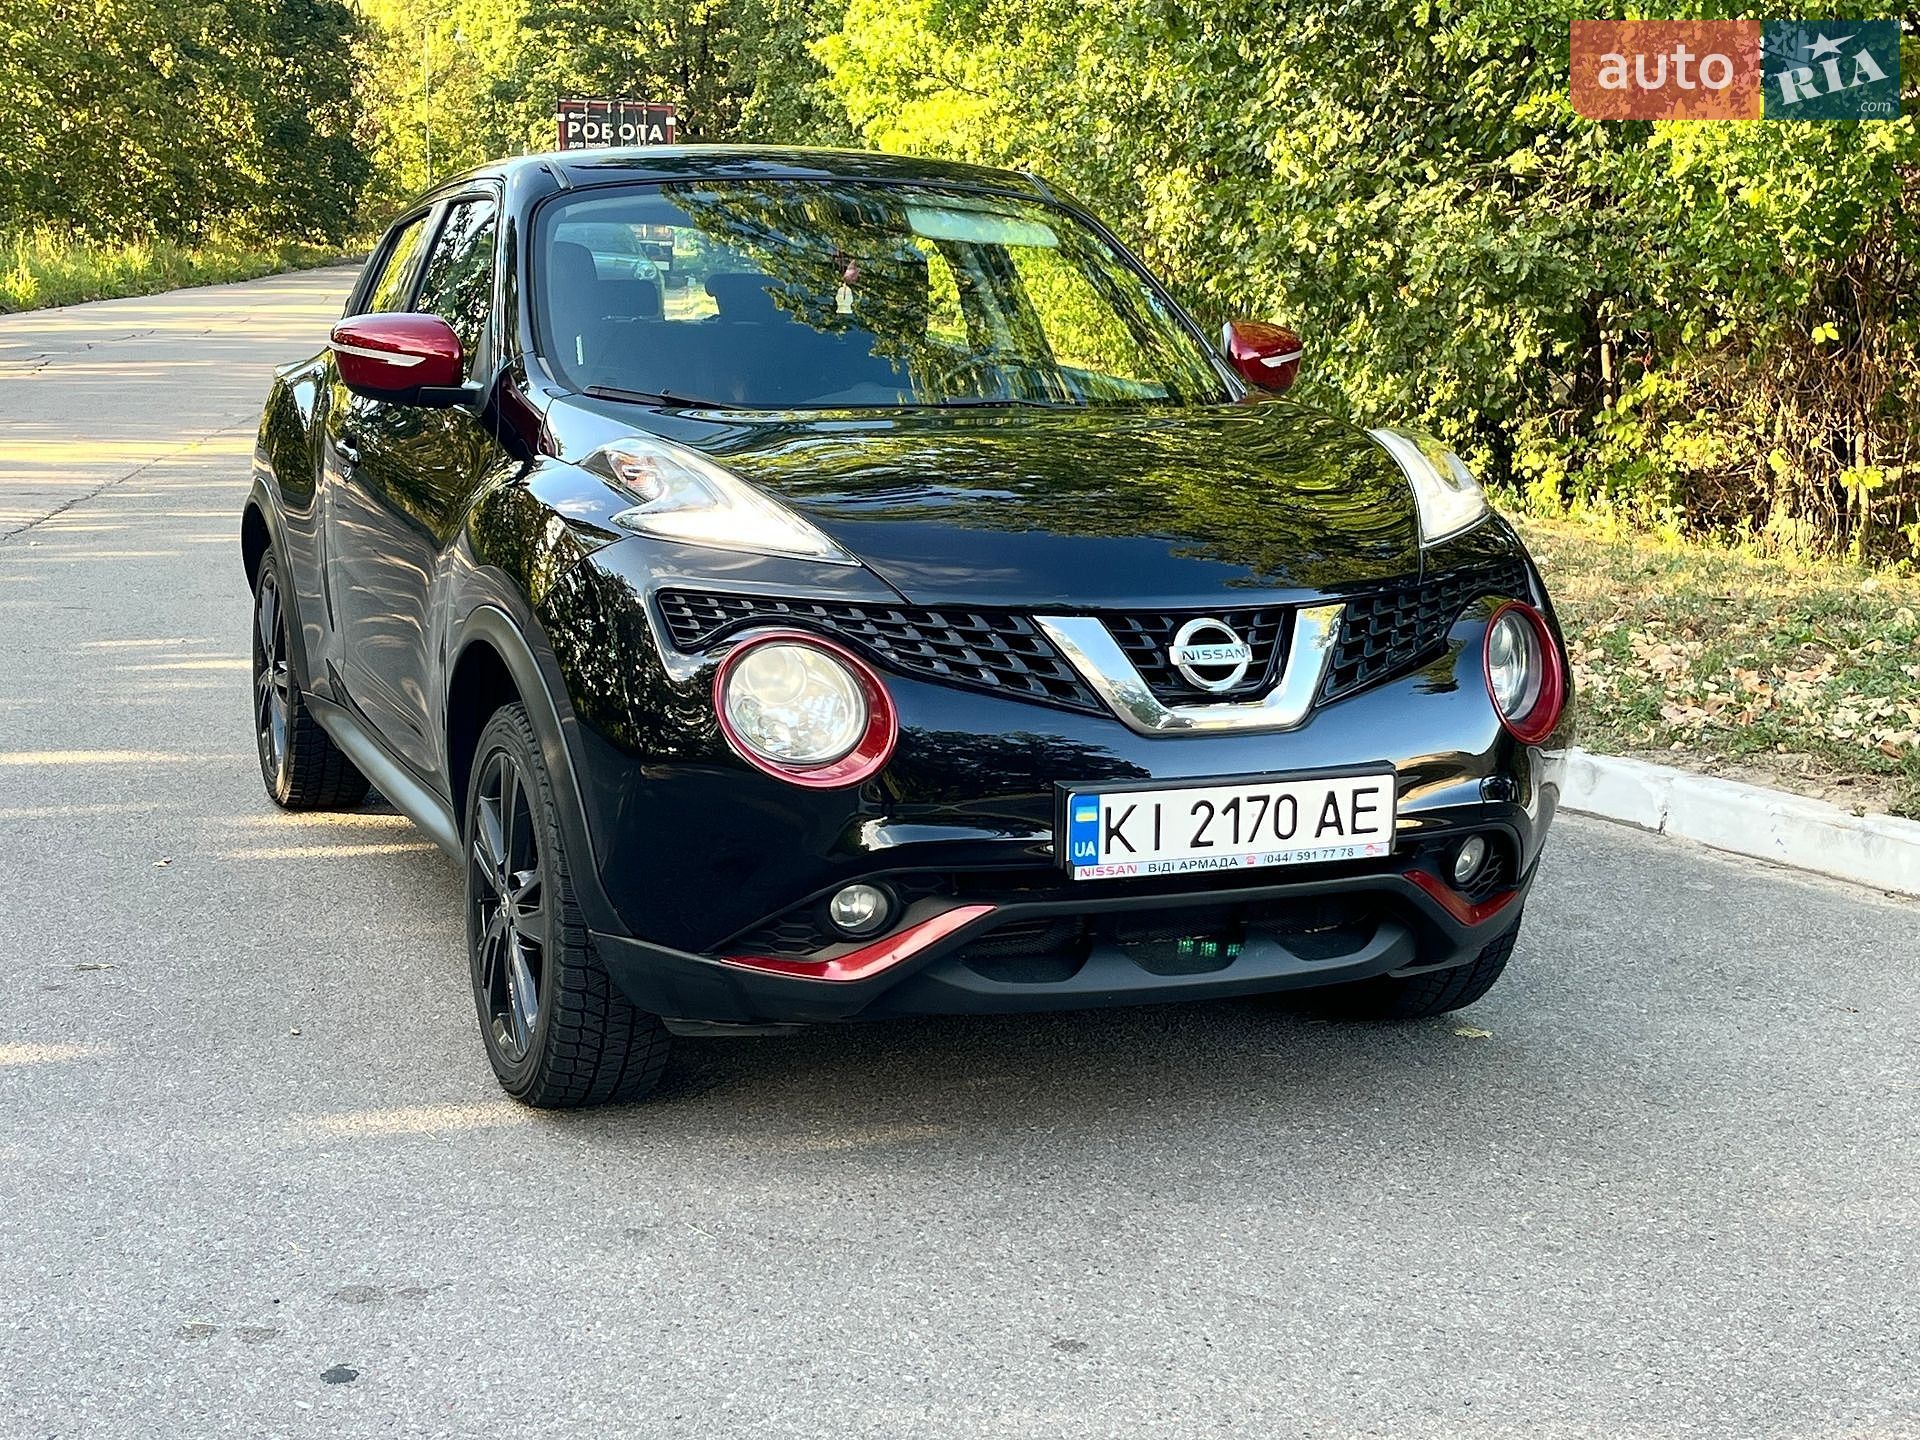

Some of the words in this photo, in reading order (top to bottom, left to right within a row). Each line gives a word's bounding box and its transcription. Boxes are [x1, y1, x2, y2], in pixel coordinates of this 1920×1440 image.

[567, 121, 664, 141] РОБОТА
[1182, 649, 1246, 661] NISSAN
[1190, 793, 1298, 848] 2170
[1314, 787, 1379, 838] AE
[1074, 841, 1096, 858] UA
[1079, 864, 1138, 878] NISSAN
[1178, 857, 1239, 871] АРМАДА
[1296, 850, 1318, 861] 591
[1322, 848, 1336, 859] 77
[1340, 847, 1354, 858] 78
